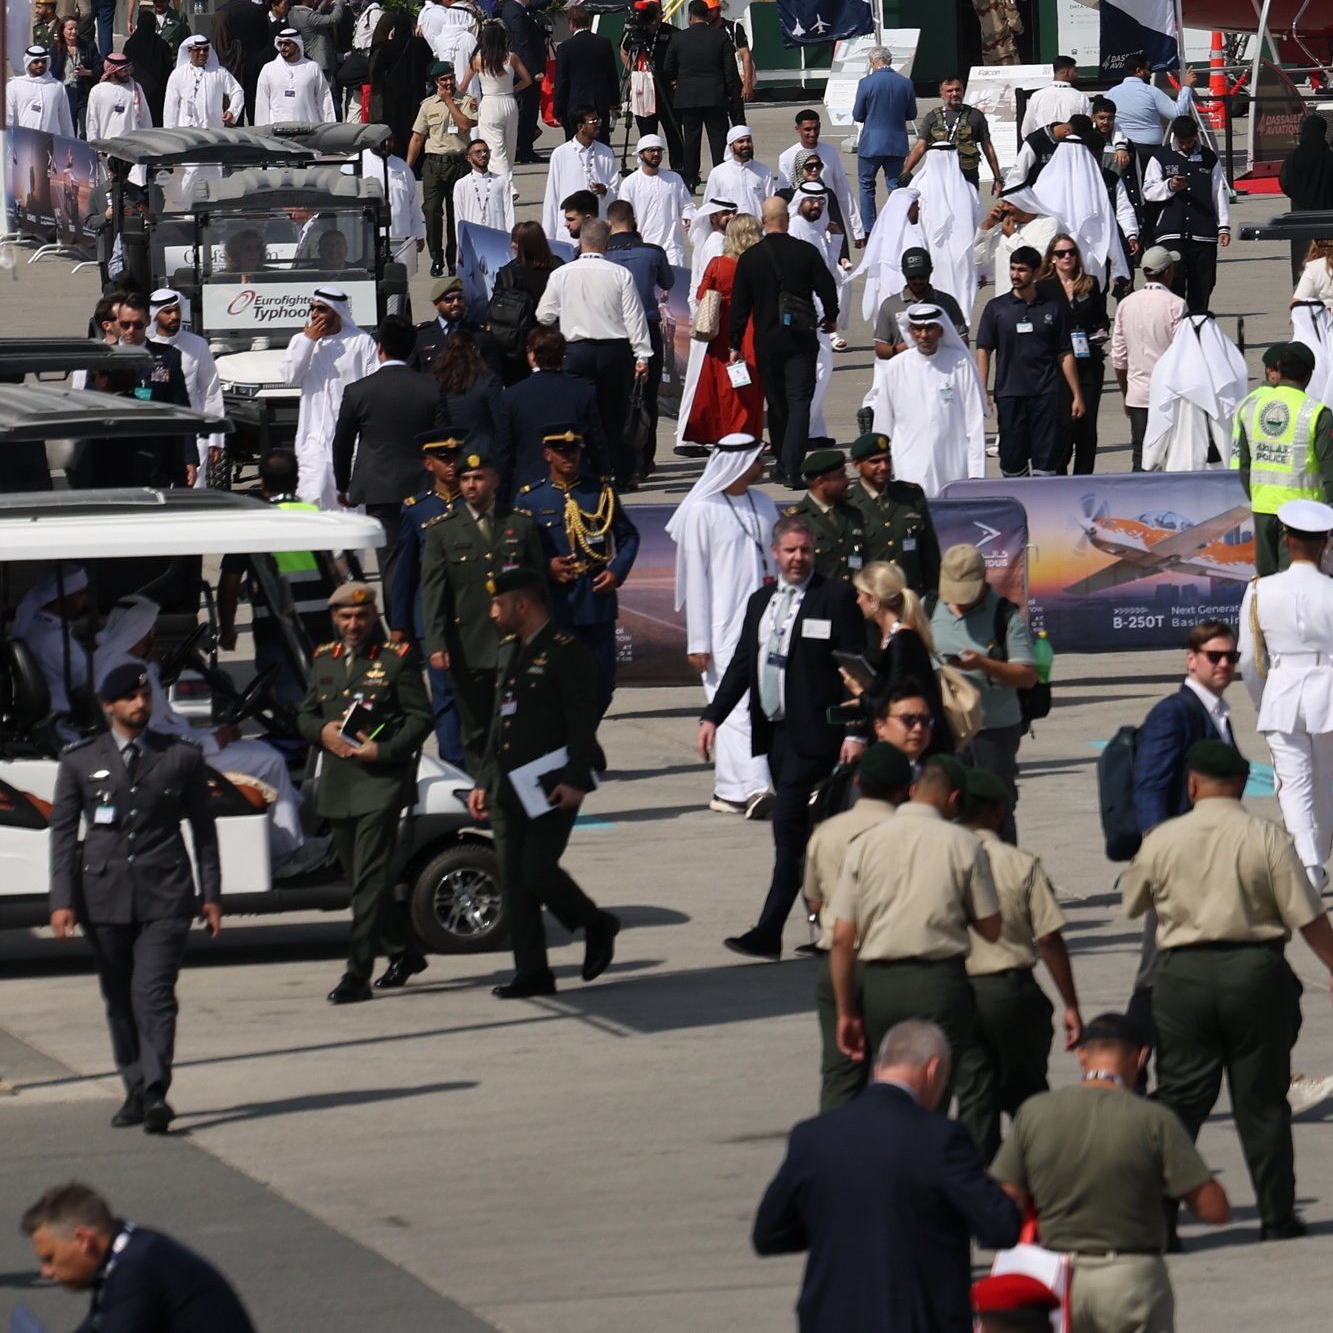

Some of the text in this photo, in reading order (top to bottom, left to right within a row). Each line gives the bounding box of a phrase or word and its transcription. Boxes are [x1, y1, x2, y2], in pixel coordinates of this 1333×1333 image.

[977, 69, 1001, 77] Falcon
[1265, 124, 1301, 135] AVIATION
[254, 295, 313, 308] Eurofighte
[1256, 452, 1287, 465] POLICE
[1171, 606, 1196, 615] Next
[1112, 616, 1165, 629] B-250T
